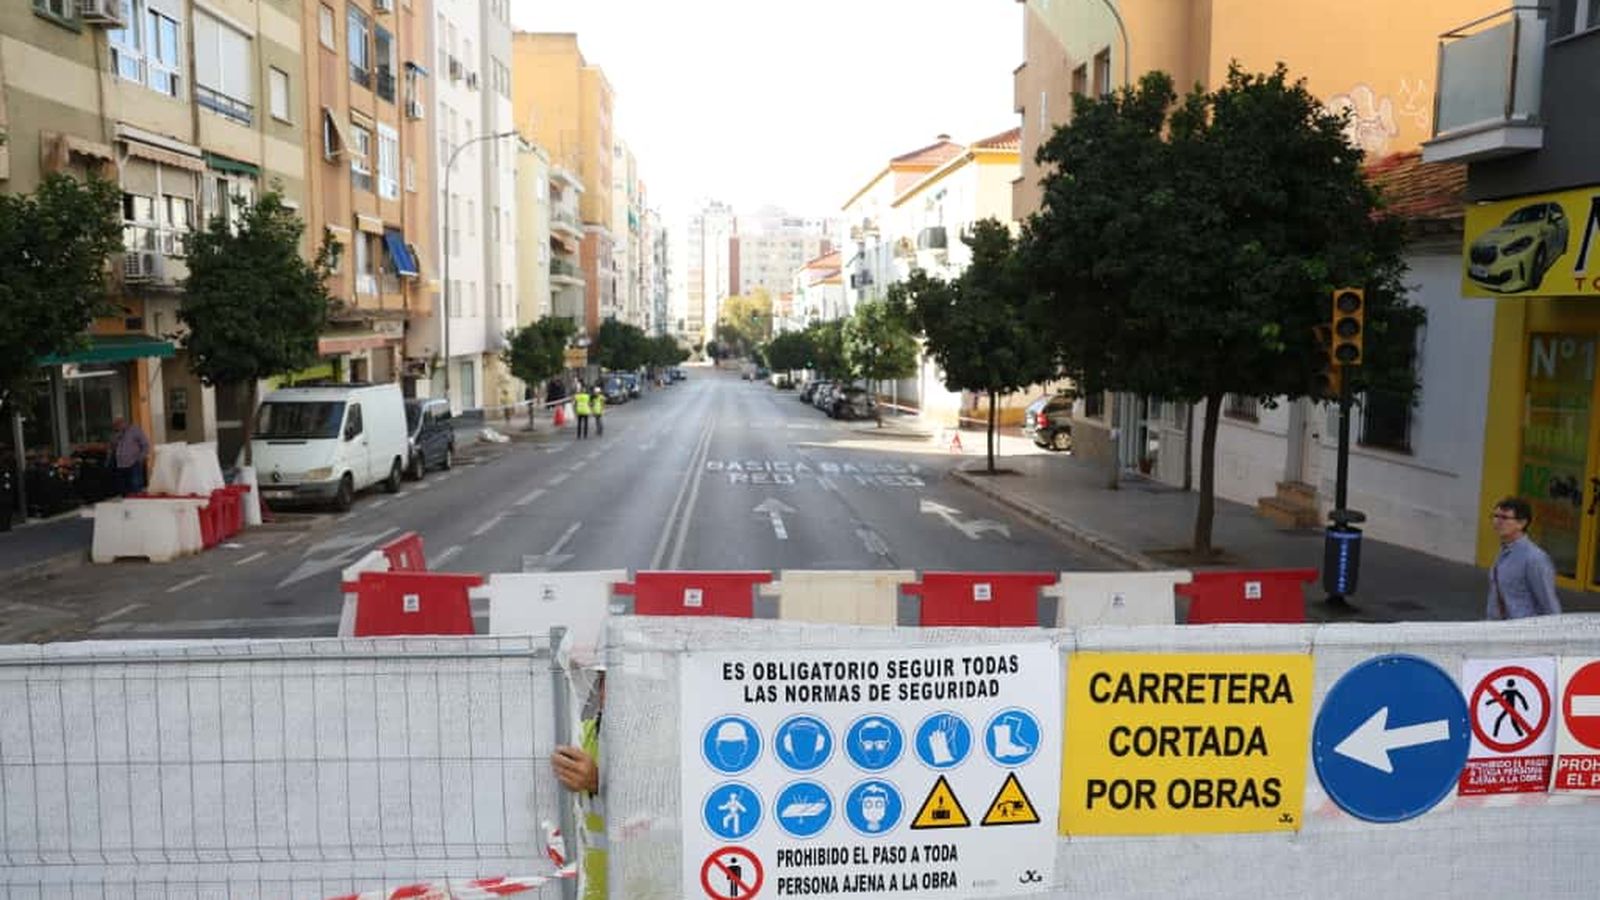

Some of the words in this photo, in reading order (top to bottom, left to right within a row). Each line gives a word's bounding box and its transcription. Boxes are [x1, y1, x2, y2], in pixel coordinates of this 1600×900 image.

[722, 662, 745, 681] ES
[752, 661, 879, 681] OBLIGATORIO
[886, 659, 955, 679] SEGUIR
[962, 655, 1019, 676] TODAS
[744, 685, 777, 703] LAS
[785, 684, 861, 703] NORMAS
[868, 683, 891, 702] DE
[898, 679, 1000, 702] SEGURIDAD
[1089, 672, 1294, 704] CARRETERA
[1108, 725, 1268, 757] CORTADA
[1567, 773, 1586, 786] EL
[1086, 779, 1157, 810] POR
[1167, 777, 1282, 809] OBRAS
[777, 847, 849, 868] PROHIBIDO
[853, 846, 869, 865] EL
[872, 846, 907, 864] PASO
[910, 845, 920, 863] A
[923, 844, 958, 863] TODA
[777, 875, 839, 896] PERSONA
[842, 874, 886, 893] AJENA
[888, 873, 898, 892] A
[902, 873, 918, 891] LA
[922, 871, 958, 890] OBRA
